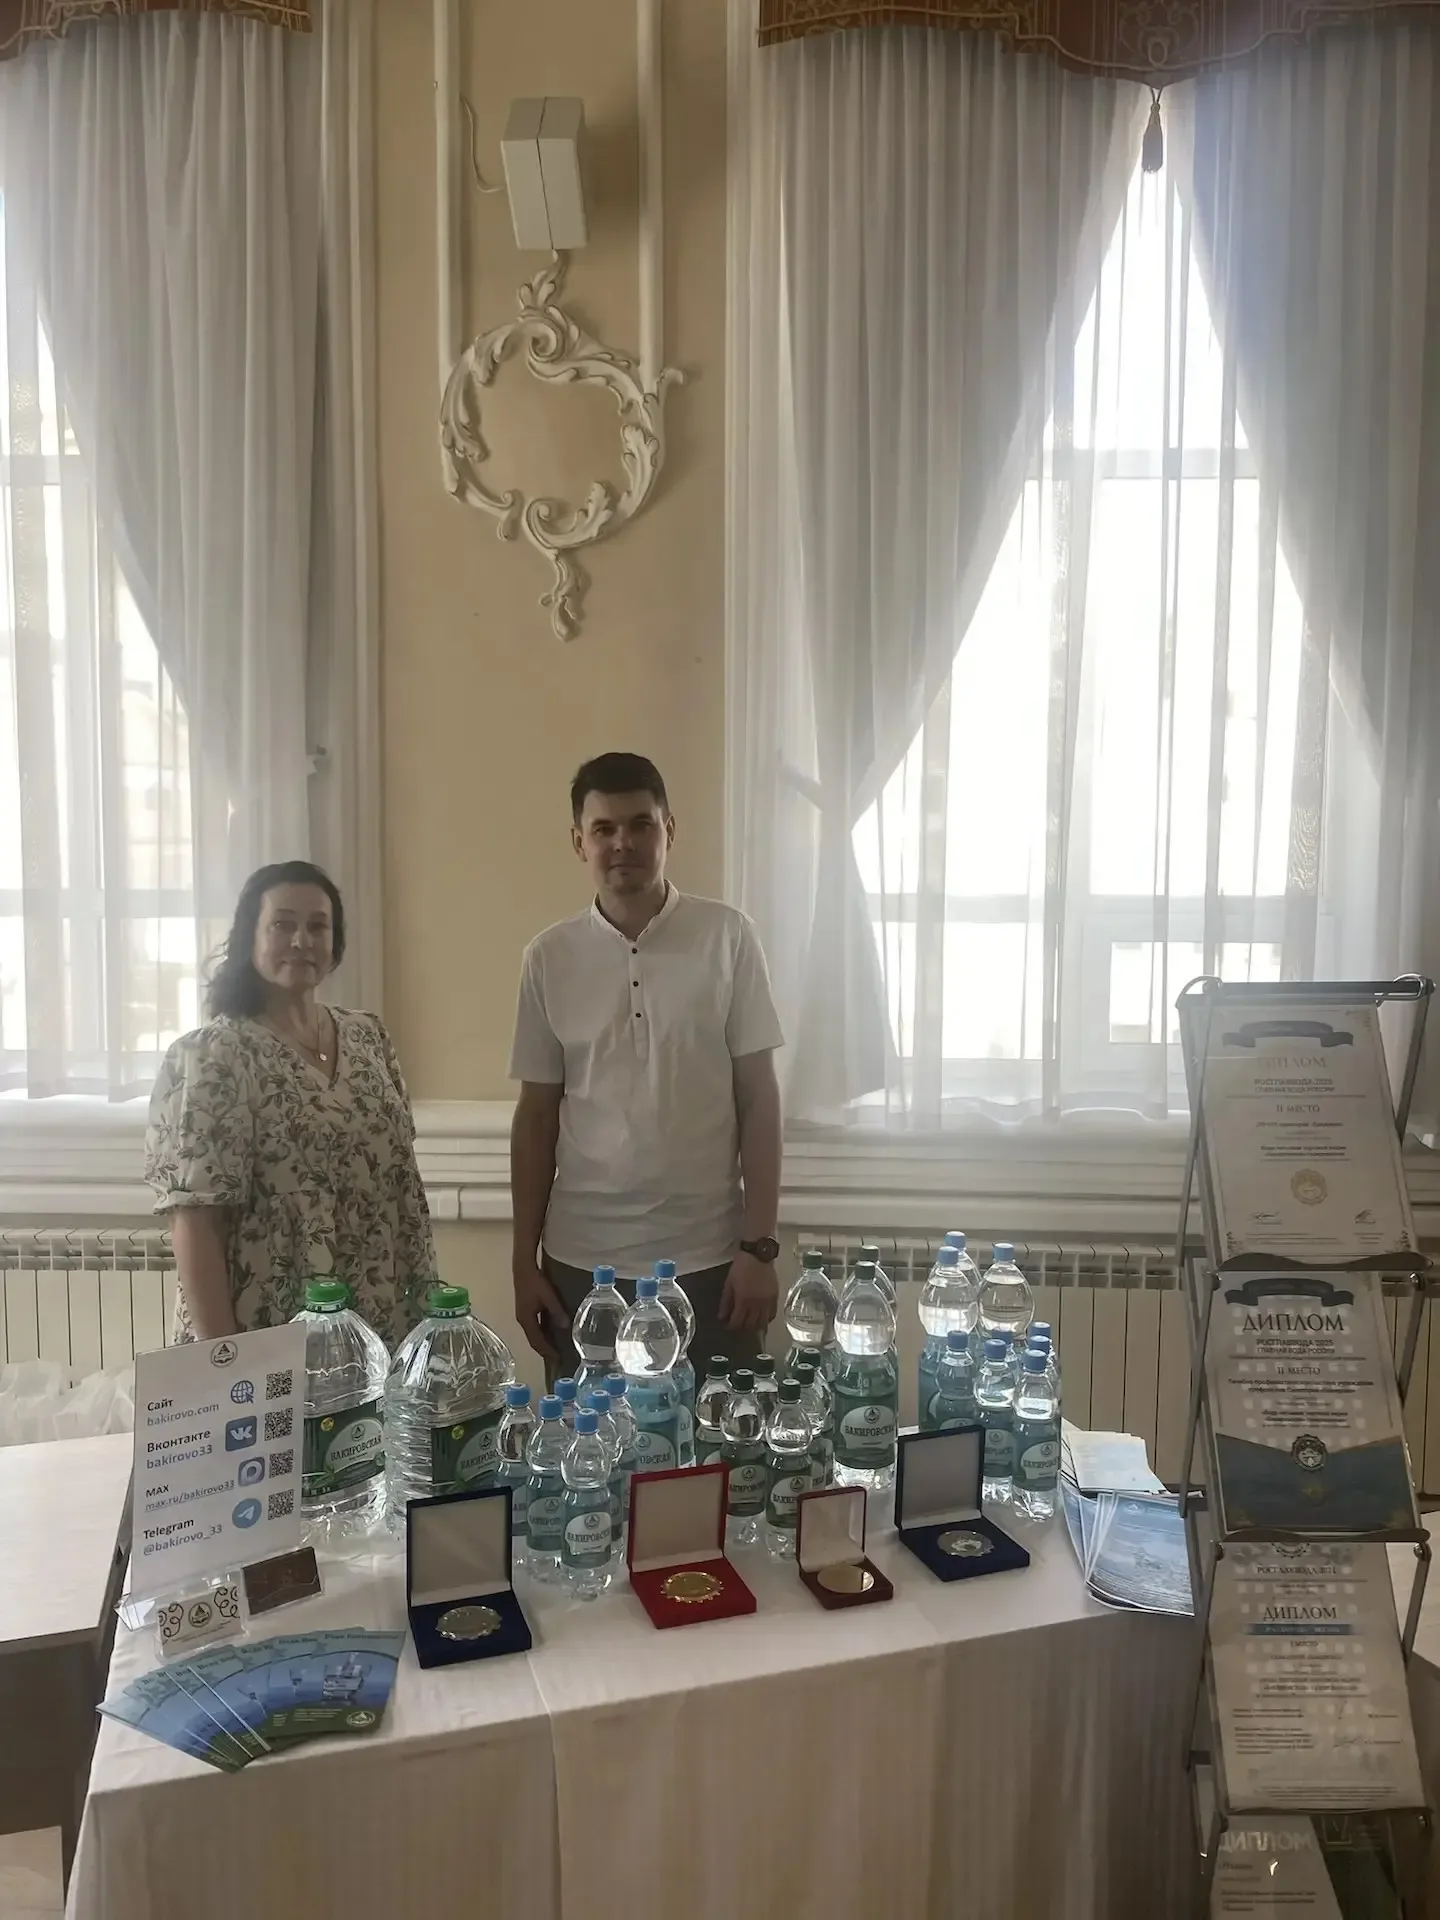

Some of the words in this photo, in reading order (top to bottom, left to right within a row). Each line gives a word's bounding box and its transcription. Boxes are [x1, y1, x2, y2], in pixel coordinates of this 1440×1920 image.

[1242, 1313, 1344, 1332] ДИПЛОМ
[1288, 1366, 1321, 1375] МЕСТО
[147, 1398, 174, 1412] Сайт
[147, 1402, 220, 1427] bakirovo.com
[844, 1424, 895, 1437] БАКИРОВСК
[147, 1430, 211, 1453] Вконтакте
[146, 1444, 213, 1470] bakirovo33
[640, 1451, 671, 1465] ОВСКАЯ
[145, 1484, 170, 1498] MAX
[145, 1479, 235, 1511] max.ru/bakirovo33
[143, 1518, 194, 1540] Telegram
[567, 1529, 610, 1542] БАКИРОВСК
[143, 1523, 223, 1556] @bakirovo_33
[1263, 1606, 1337, 1622] ДИПЛОМ
